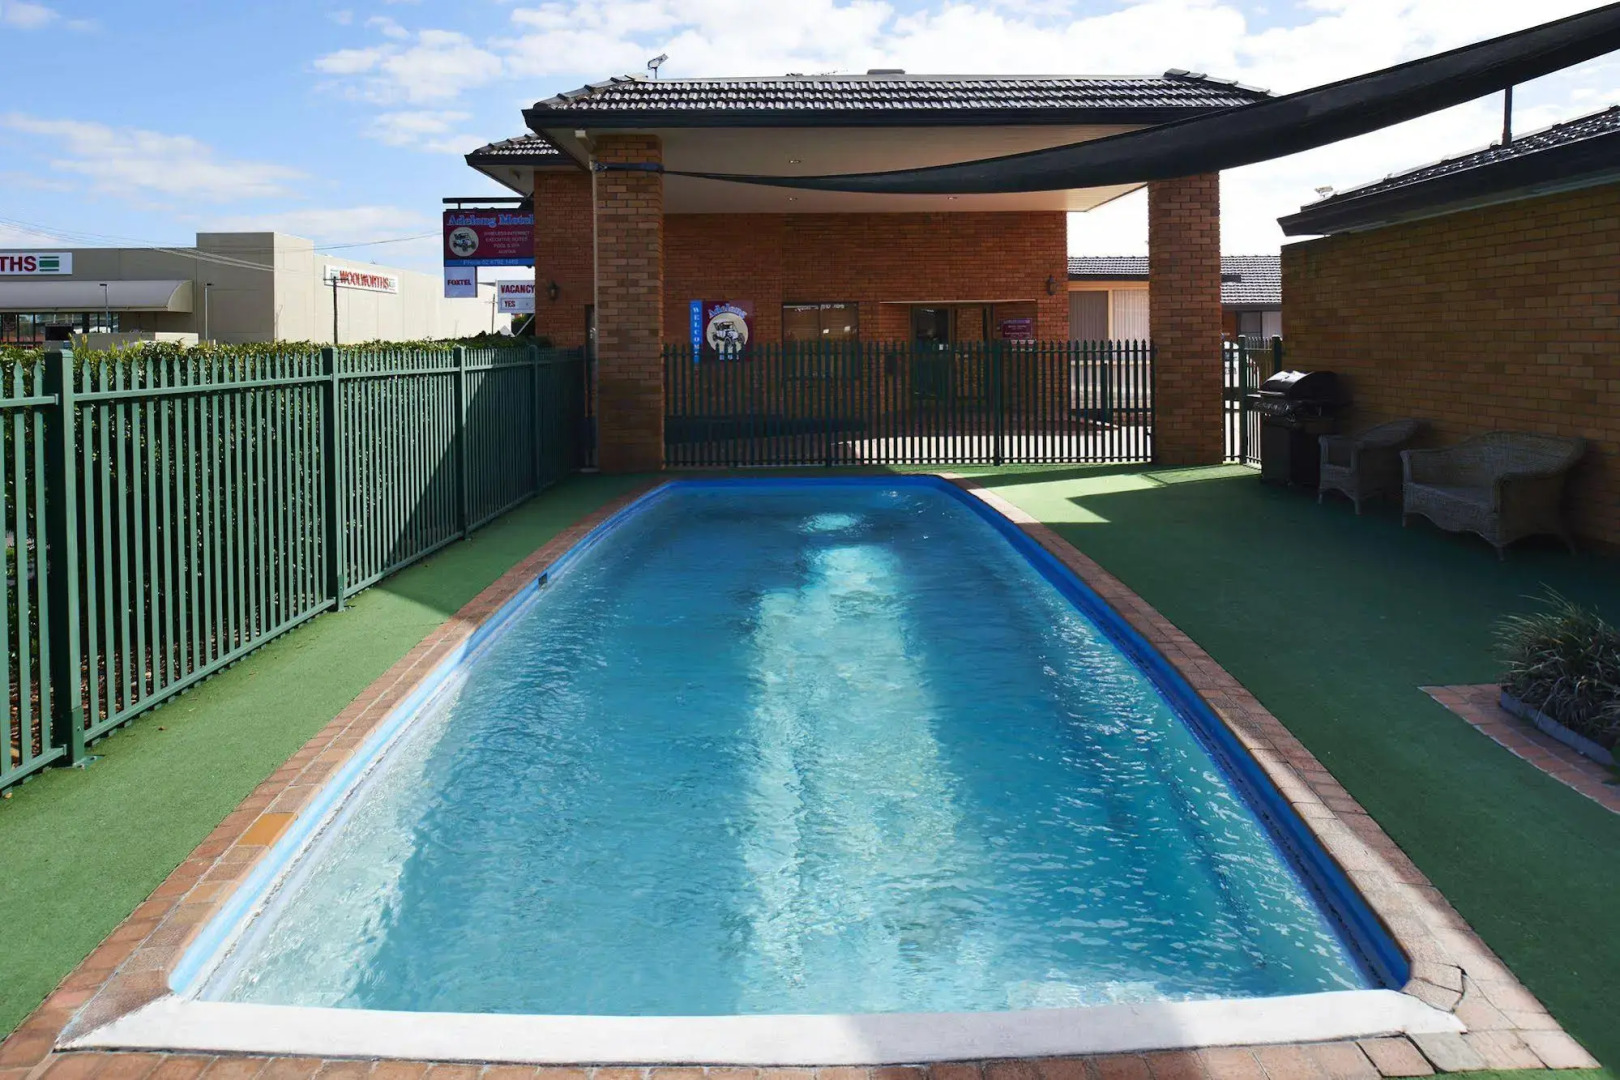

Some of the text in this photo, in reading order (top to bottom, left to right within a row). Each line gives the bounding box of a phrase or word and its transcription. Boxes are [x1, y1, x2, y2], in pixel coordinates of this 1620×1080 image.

[447, 213, 534, 228] Adelong Motel
[339, 270, 389, 289] WOOLWORTHS
[500, 284, 535, 294] VACANCY
[504, 300, 516, 308] YES
[708, 303, 748, 320] Adelong
